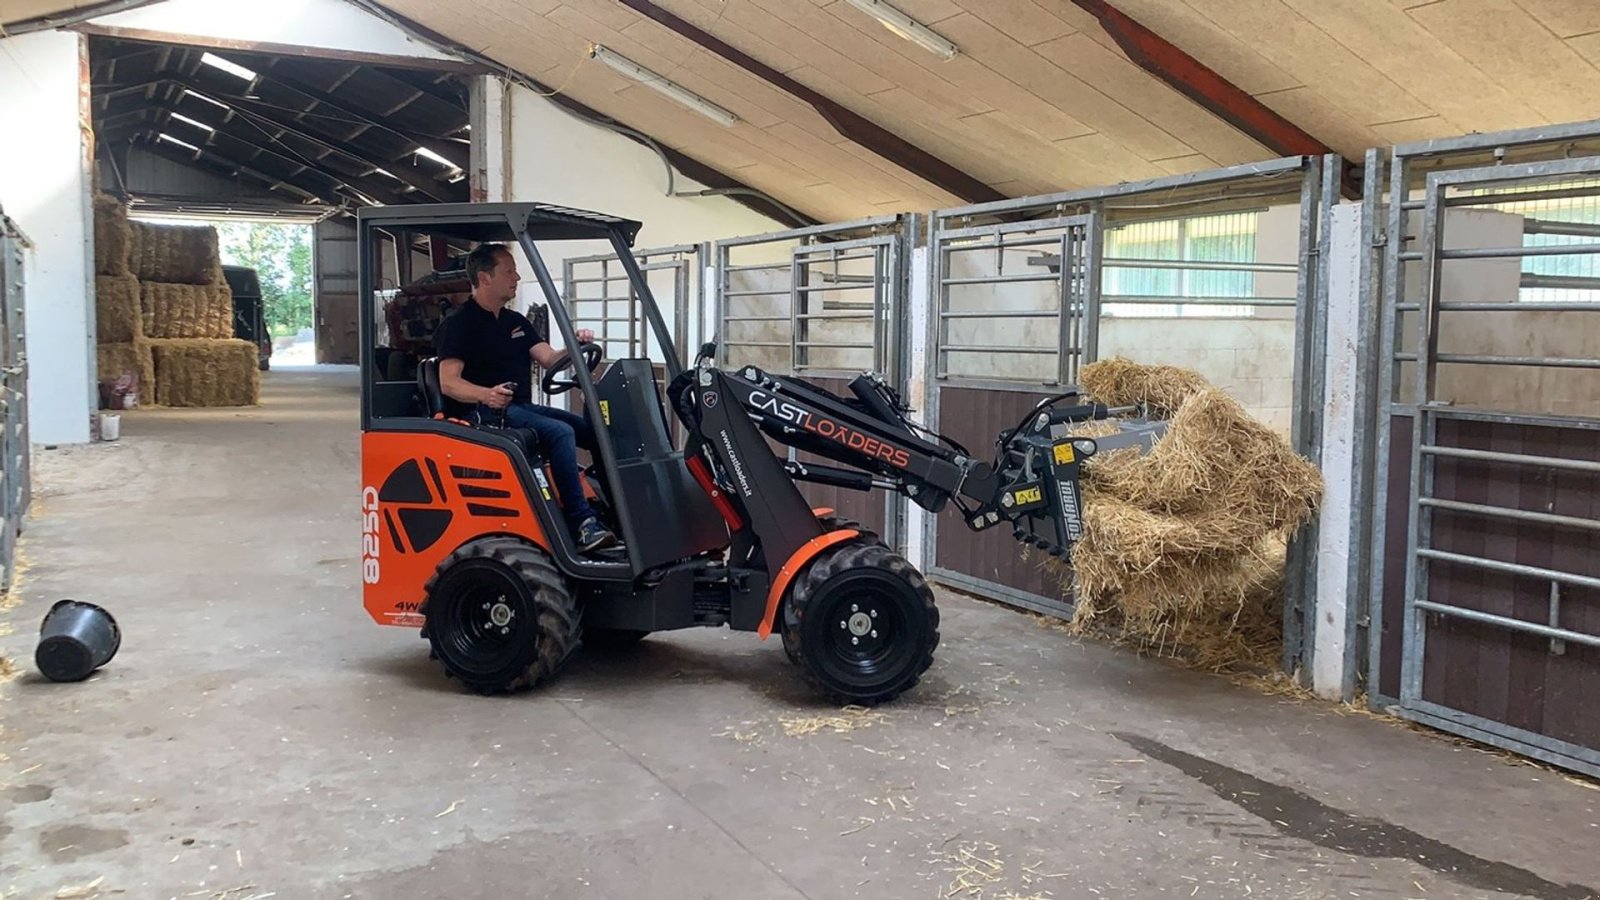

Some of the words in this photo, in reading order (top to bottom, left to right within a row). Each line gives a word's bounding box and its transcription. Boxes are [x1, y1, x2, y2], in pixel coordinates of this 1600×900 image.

[720, 429, 752, 497] www.castloaders.it
[362, 486, 380, 585] 825D
[1060, 480, 1082, 541] SONAROL
[395, 601, 419, 611] 4W
